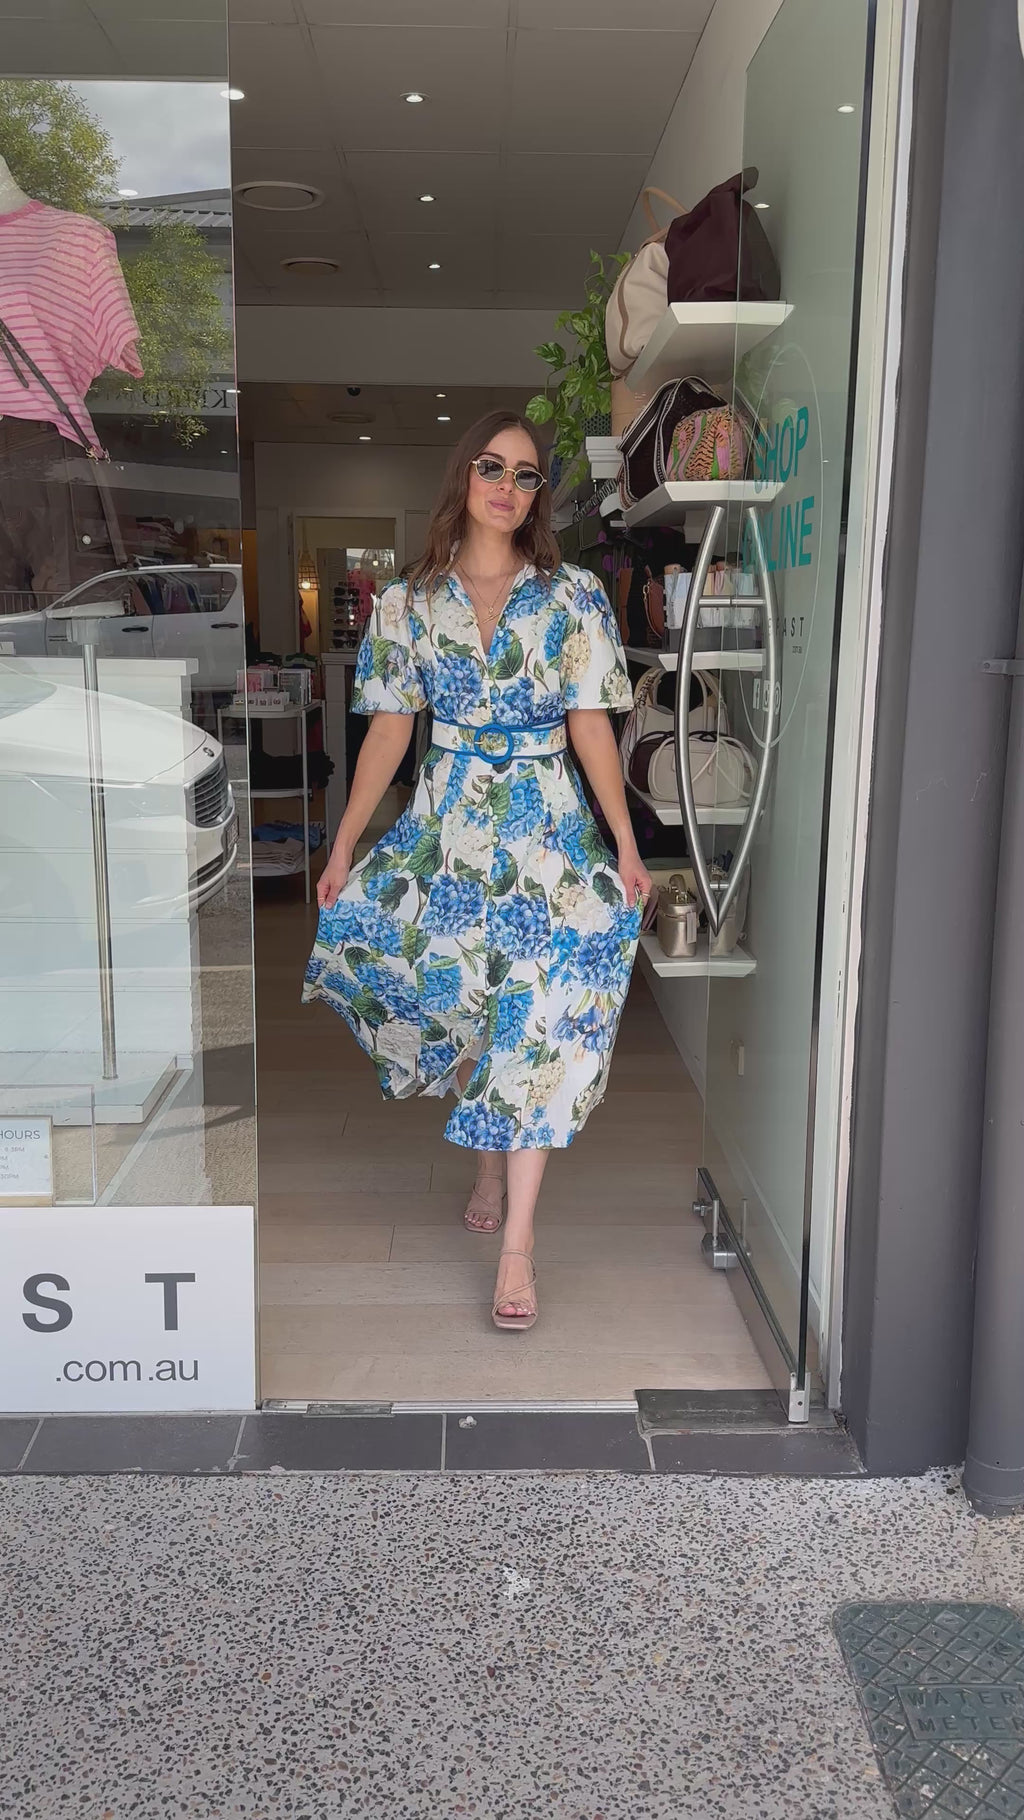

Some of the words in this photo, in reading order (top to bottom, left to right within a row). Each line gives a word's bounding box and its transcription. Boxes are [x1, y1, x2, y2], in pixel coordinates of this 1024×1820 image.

[754, 406, 809, 494] SHOP
[56, 1359, 199, 1382] .com.au
[907, 1690, 1017, 1706] WATER
